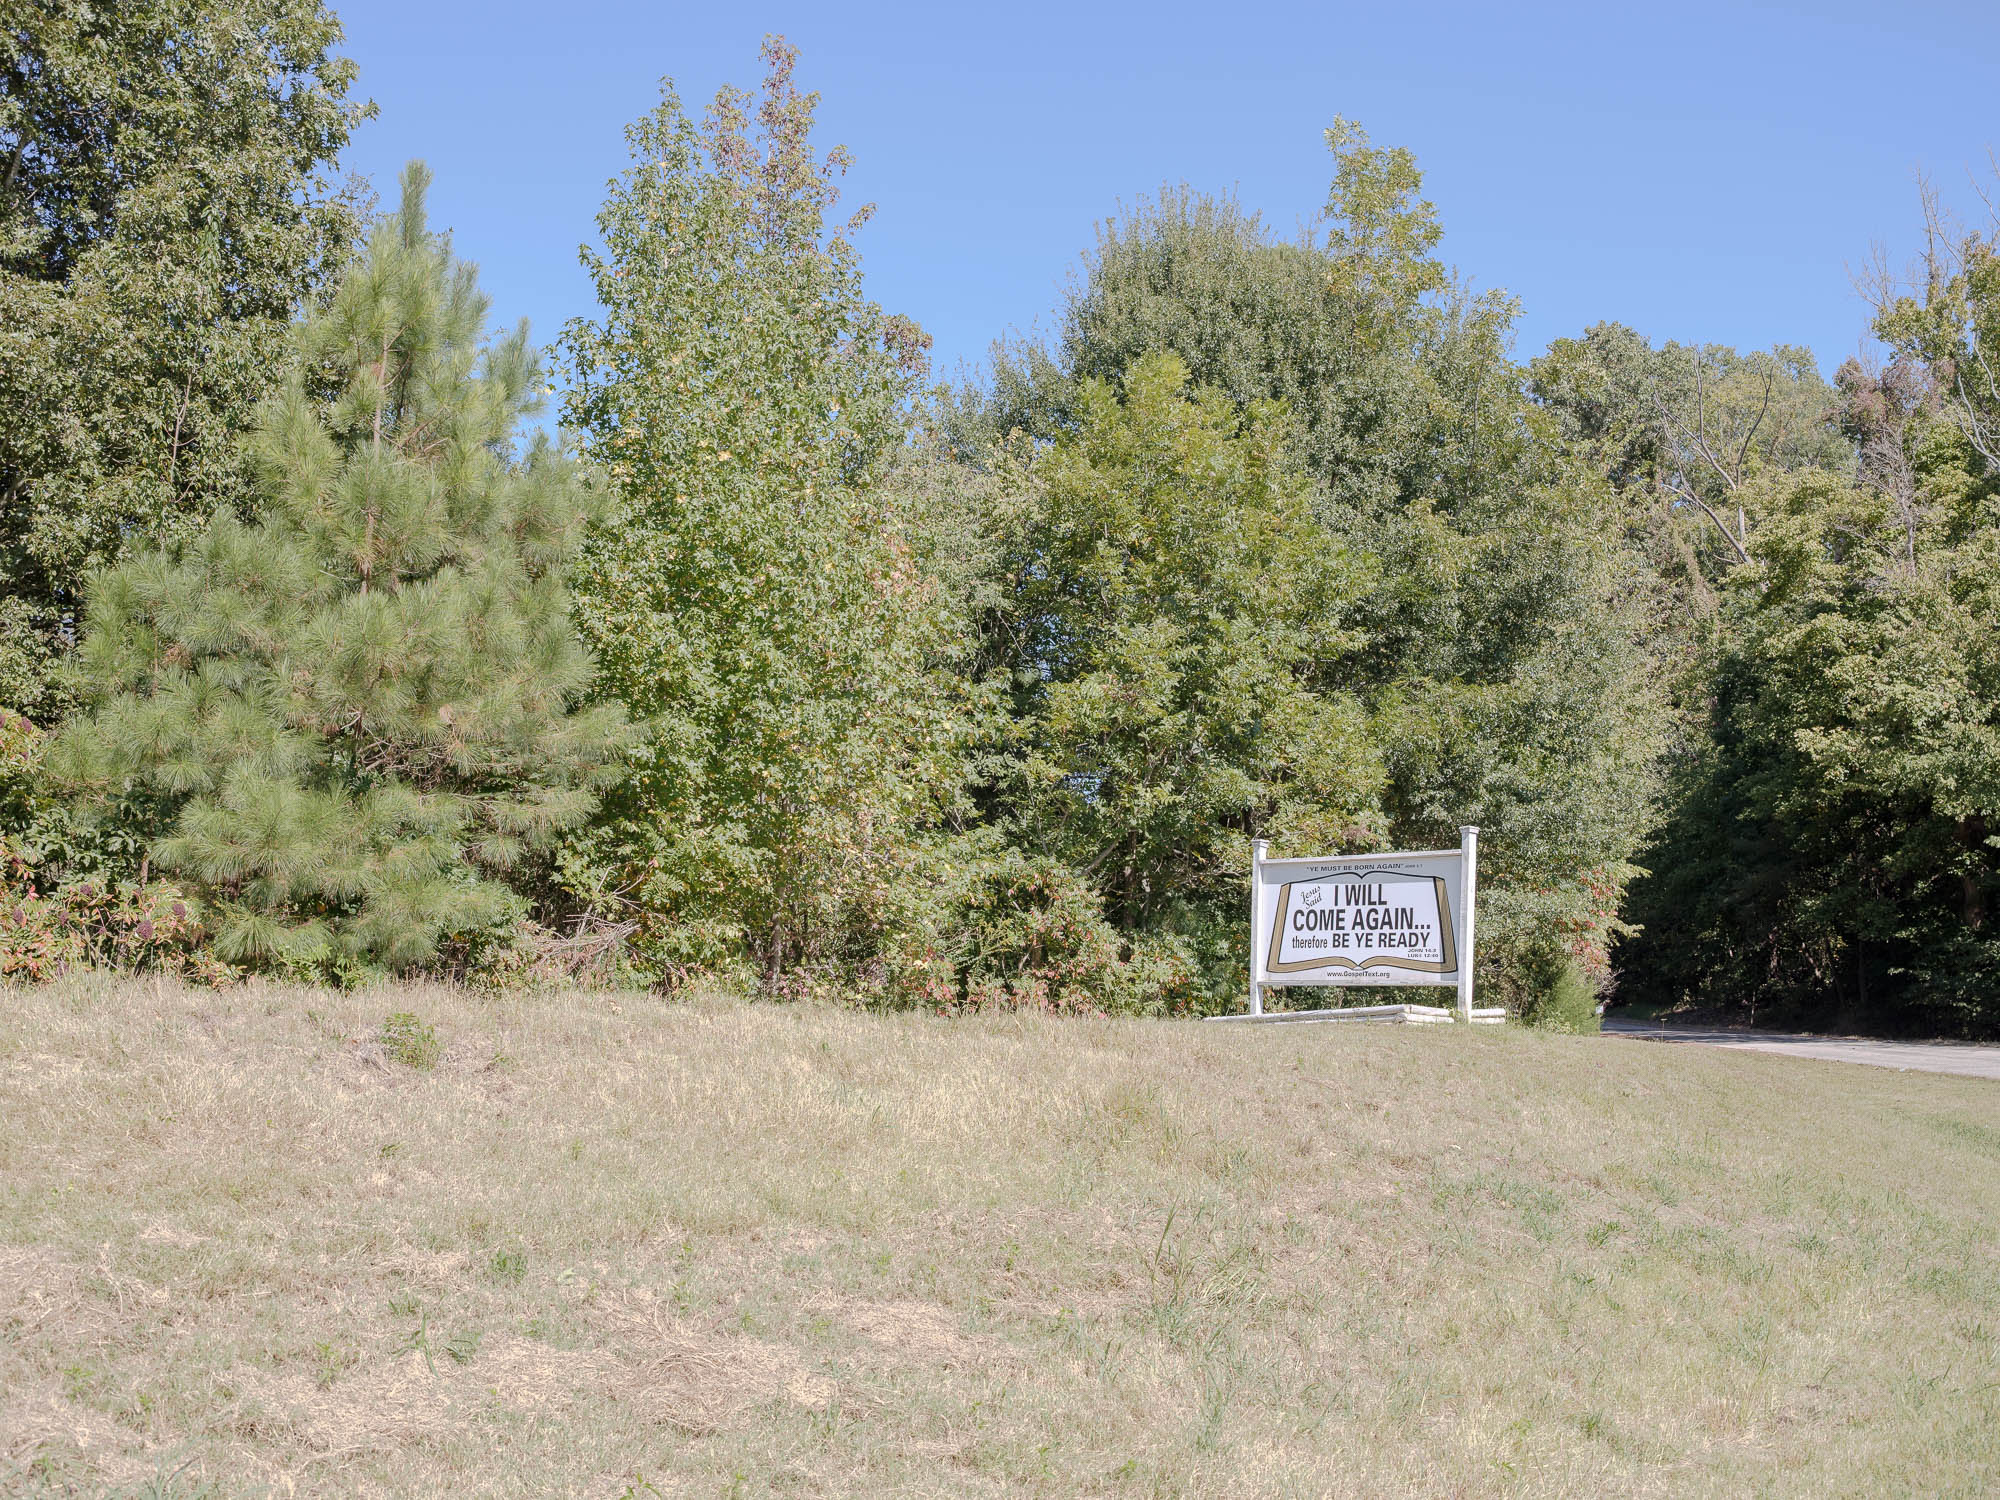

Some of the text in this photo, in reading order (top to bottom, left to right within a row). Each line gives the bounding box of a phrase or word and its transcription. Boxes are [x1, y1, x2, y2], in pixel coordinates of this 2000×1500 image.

[1300, 885, 1321, 905] Jesus
[1305, 892, 1322, 909] Said
[1334, 884, 1387, 906] I WILL
[1293, 907, 1431, 931] COME AGAIN...
[1292, 932, 1430, 949] therefore BE YE READY
[1327, 970, 1391, 978] www.GospelText.org
